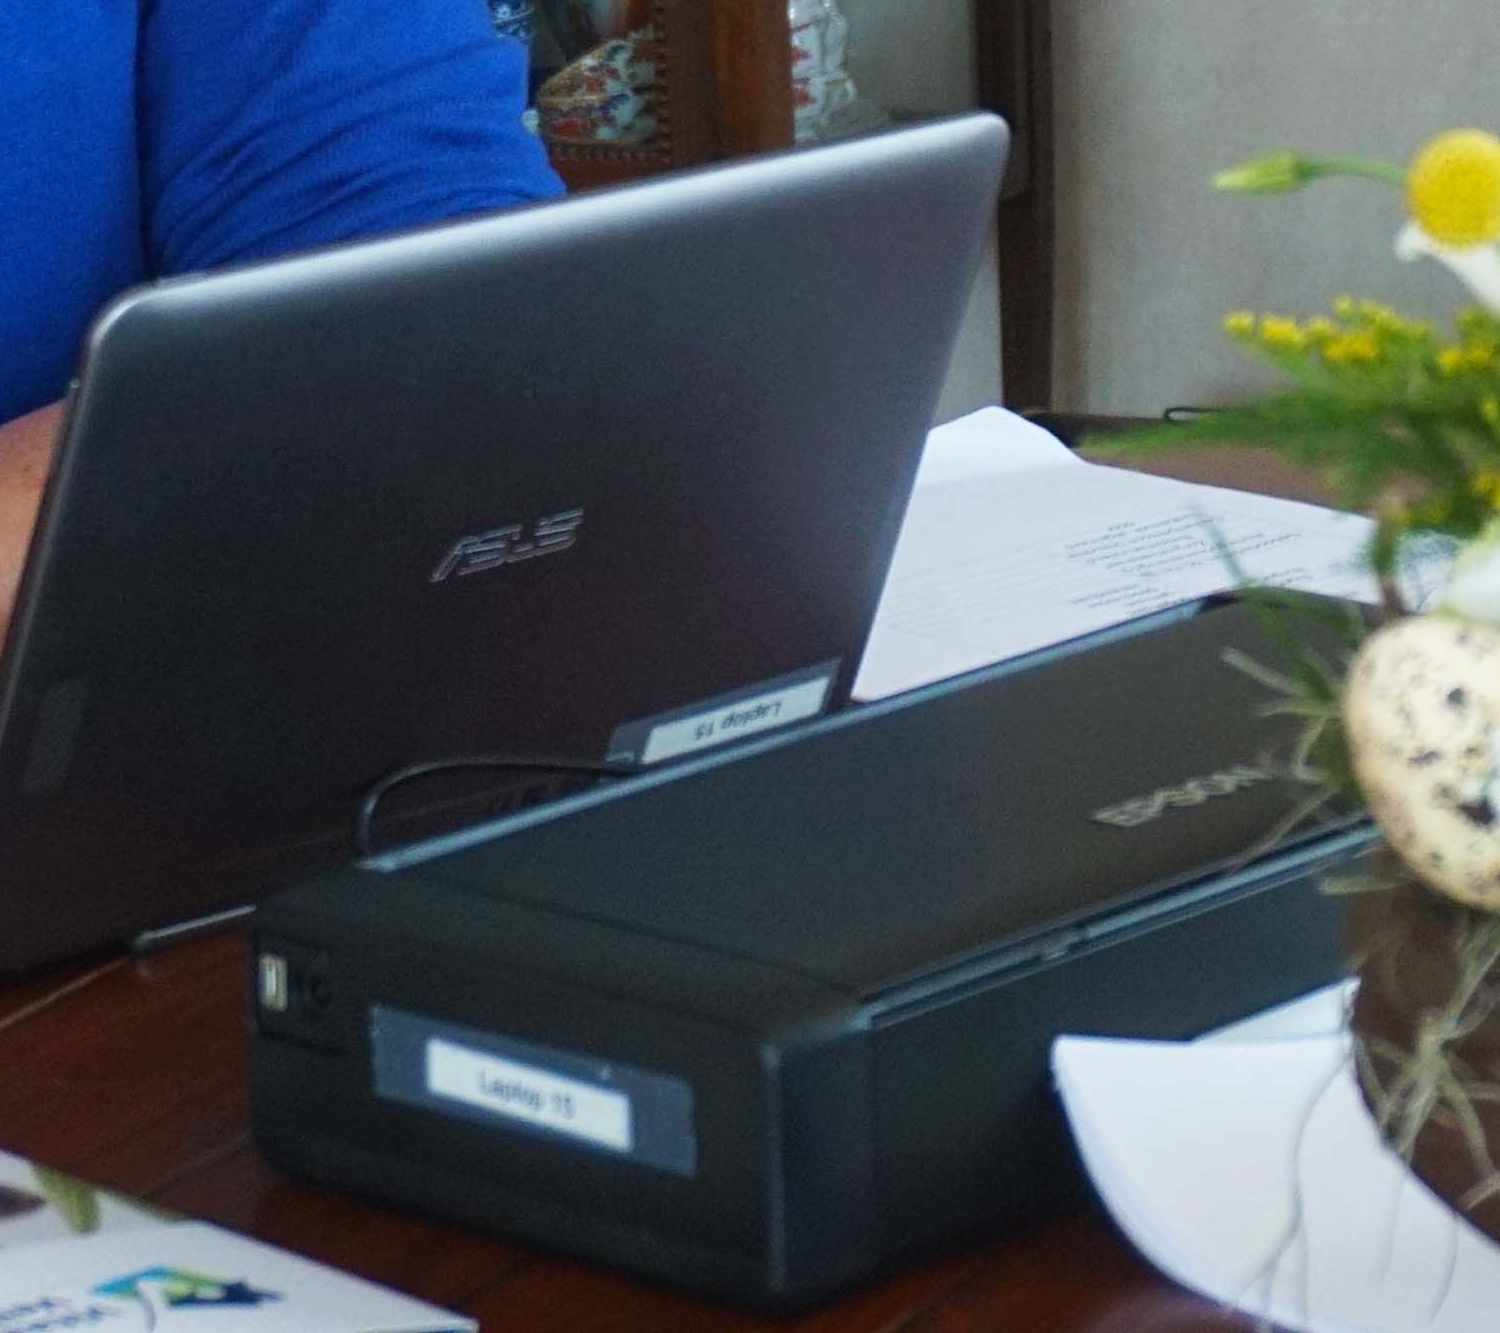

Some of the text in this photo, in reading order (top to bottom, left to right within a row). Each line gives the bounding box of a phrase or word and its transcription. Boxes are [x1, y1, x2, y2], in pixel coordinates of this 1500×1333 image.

[430, 508, 585, 583] ASUS
[721, 700, 784, 732] Laptop
[477, 1068, 544, 1112] Laptop
